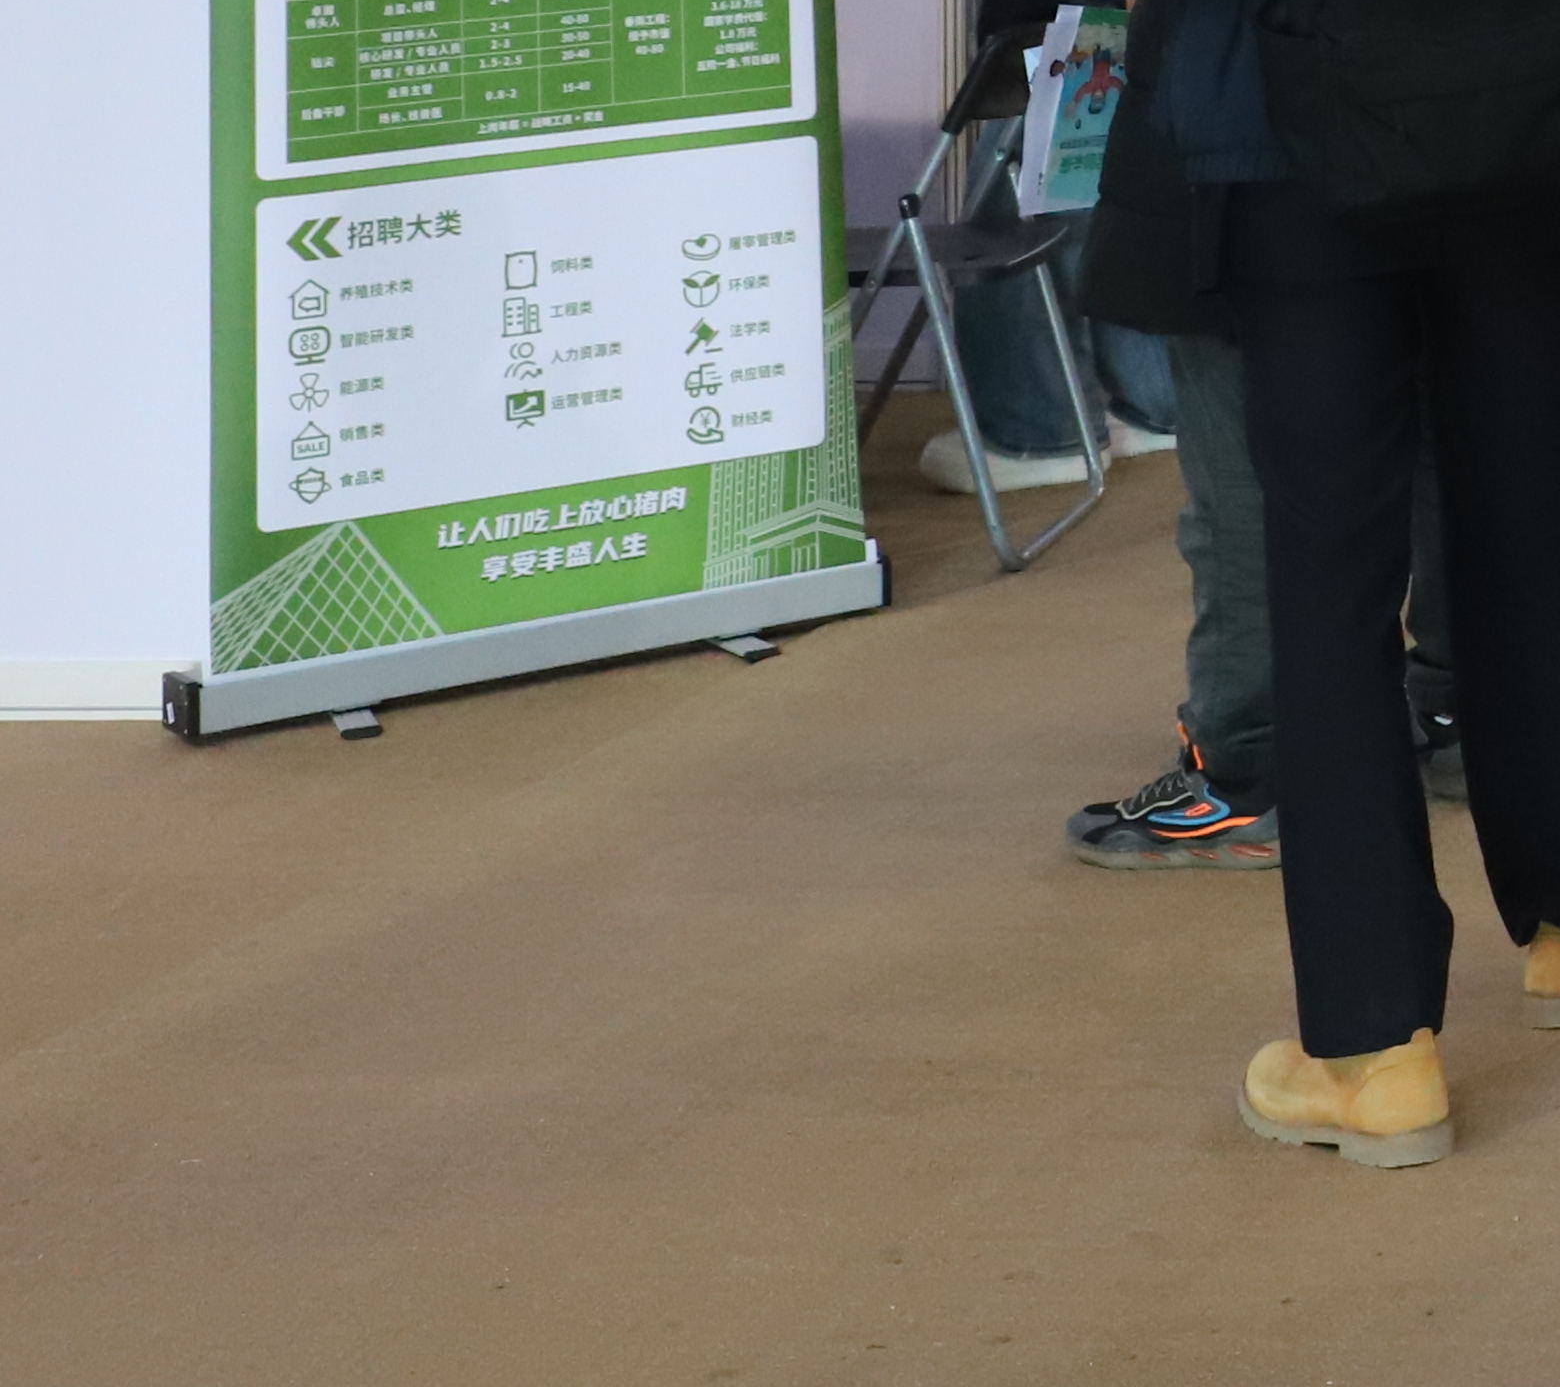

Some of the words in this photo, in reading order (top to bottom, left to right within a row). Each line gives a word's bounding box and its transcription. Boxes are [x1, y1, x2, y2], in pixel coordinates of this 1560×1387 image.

[346, 209, 463, 250] 招聘大类
[550, 256, 594, 275] 饲料类
[339, 279, 414, 301] 养殖技术类
[728, 275, 771, 293] 环保类
[549, 301, 593, 319] 工程类
[339, 325, 415, 349] 智能研发类
[729, 321, 771, 339] 法学类
[551, 341, 623, 365] 人力资源类
[730, 363, 786, 383] 供应链类
[339, 377, 385, 396] 能源类
[550, 387, 624, 411] 运营管理类
[731, 410, 773, 428] 财经类
[339, 423, 385, 442] 销售类
[296, 441, 326, 455] SALE
[339, 469, 385, 488] 食品类
[436, 485, 688, 550] 让人们吃上放心猪肉
[479, 532, 649, 584] 享受丰盛人生
